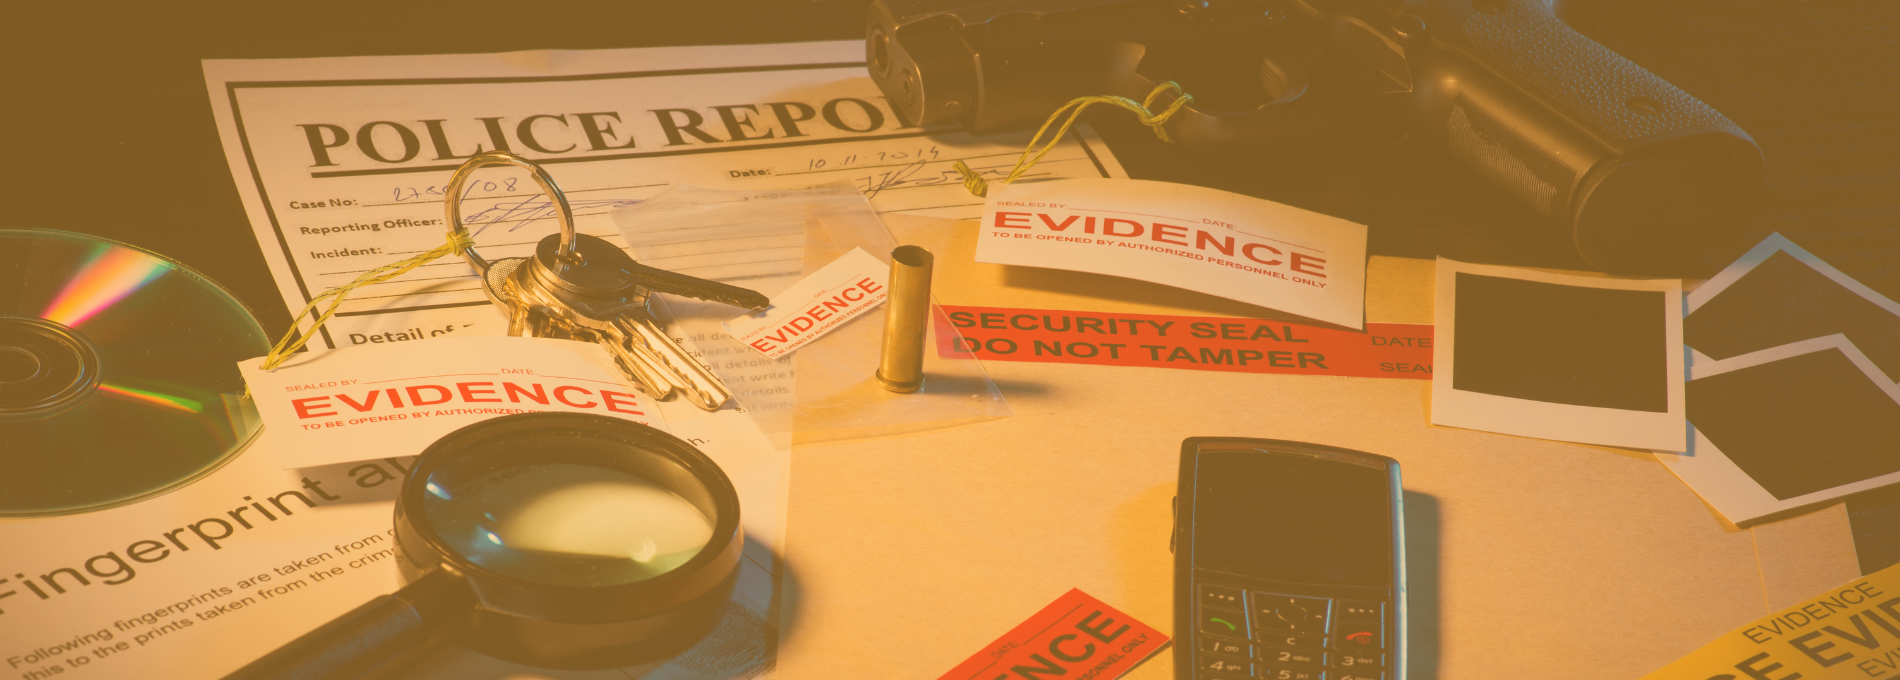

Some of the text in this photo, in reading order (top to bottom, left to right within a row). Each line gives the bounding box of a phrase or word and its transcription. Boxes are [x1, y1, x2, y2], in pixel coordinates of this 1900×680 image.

[296, 97, 918, 168] POLICE REPO
[729, 168, 771, 178] Date:
[289, 197, 358, 210] Case No:
[300, 218, 443, 235] Reporting Officer:
[1202, 218, 1237, 231] DATE:
[310, 247, 382, 259] Incident:
[994, 211, 1327, 278] EVIDENCE
[1036, 234, 1092, 244] OPENED
[1117, 241, 1204, 261] AUTHORIZED
[1207, 256, 1289, 280] PERSONNEL
[1292, 276, 1327, 289] ONLY
[750, 277, 883, 353] EVIDENCE
[349, 327, 424, 345] Detail
[777, 347, 787, 355] BE
[785, 337, 808, 351] OPENED
[806, 332, 815, 340] BY
[815, 314, 848, 335] AUTHORIZED
[846, 299, 878, 317] PERSONNEL
[949, 311, 1309, 343] SECURITY SEAL
[1371, 336, 1433, 348] DATE
[952, 336, 1330, 370] DO NOT TAMPER
[725, 357, 772, 370] details
[285, 381, 337, 392] SEALED
[341, 378, 362, 386] BY:
[750, 371, 787, 382] write
[291, 381, 645, 419] EVIDENCE
[348, 413, 407, 425] OPENED
[412, 410, 431, 419] BY
[435, 407, 524, 417] AUTHORIZED
[6, 533, 384, 669] Following fingerprints are taken from
[22, 546, 396, 680] this to the prints taken from the crim
[1741, 581, 1884, 645] EVIDENCE
[992, 610, 1131, 680] NCE
[1121, 632, 1149, 653] ONLY
[1210, 660, 1241, 672] 4 ghi
[1278, 652, 1311, 662] 2 abc
[1341, 656, 1374, 666] 3 def
[1856, 647, 1900, 678] EVI
[1278, 669, 1291, 680] 5
